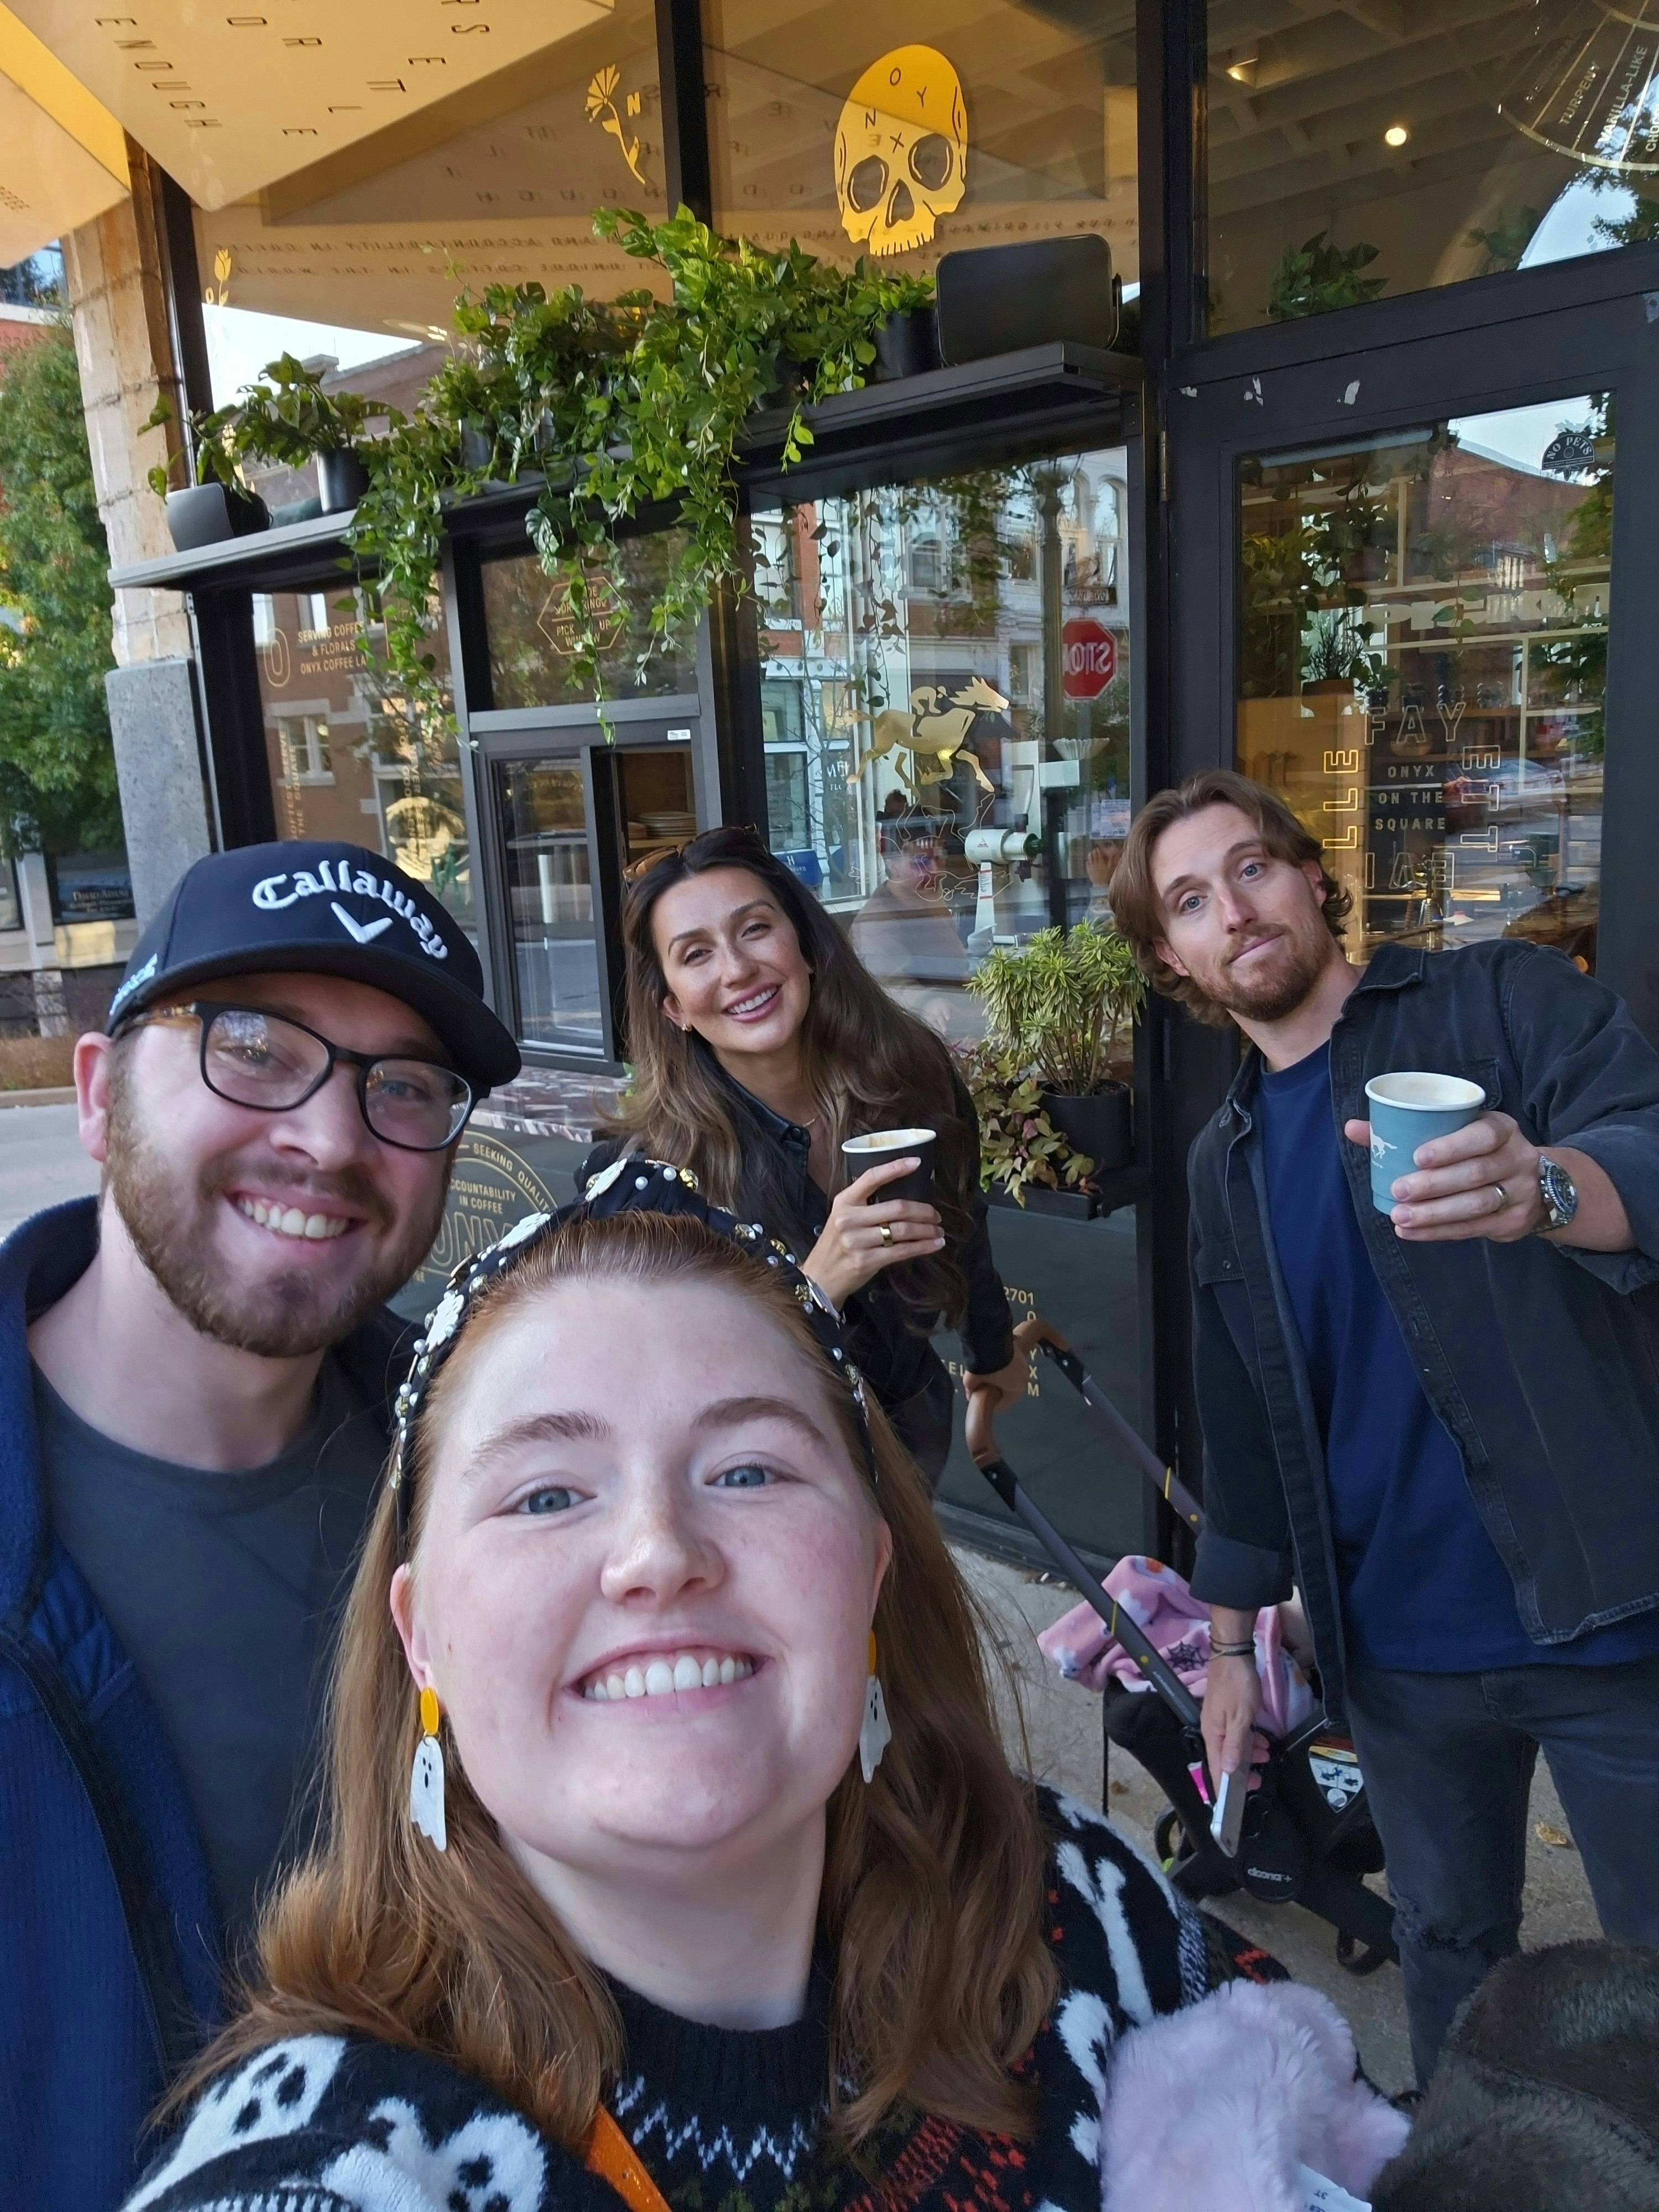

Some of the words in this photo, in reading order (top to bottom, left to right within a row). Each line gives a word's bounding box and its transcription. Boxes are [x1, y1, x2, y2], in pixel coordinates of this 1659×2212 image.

[1546, 442, 1562, 461] NO
[1566, 436, 1593, 456] PETS
[298, 627, 332, 643] SERVING
[556, 623, 575, 637] PICK
[311, 646, 319, 656] &
[320, 639, 356, 655] FLORALS
[300, 661, 322, 675] ONYX
[323, 656, 353, 672] COFFEE
[356, 654, 367, 667] LA
[1387, 765, 1434, 779] ONYX
[1378, 792, 1400, 804] ON
[1411, 791, 1443, 804] THE
[1375, 817, 1446, 831] SQUARE
[252, 860, 448, 959] Callaway
[473, 1142, 513, 1171] SEEKING
[518, 1170, 550, 1211] QUALIT
[450, 1179, 516, 1202] CCOUNTABILITY
[459, 1195, 468, 1206] IN
[471, 1199, 503, 1214] COFFEE
